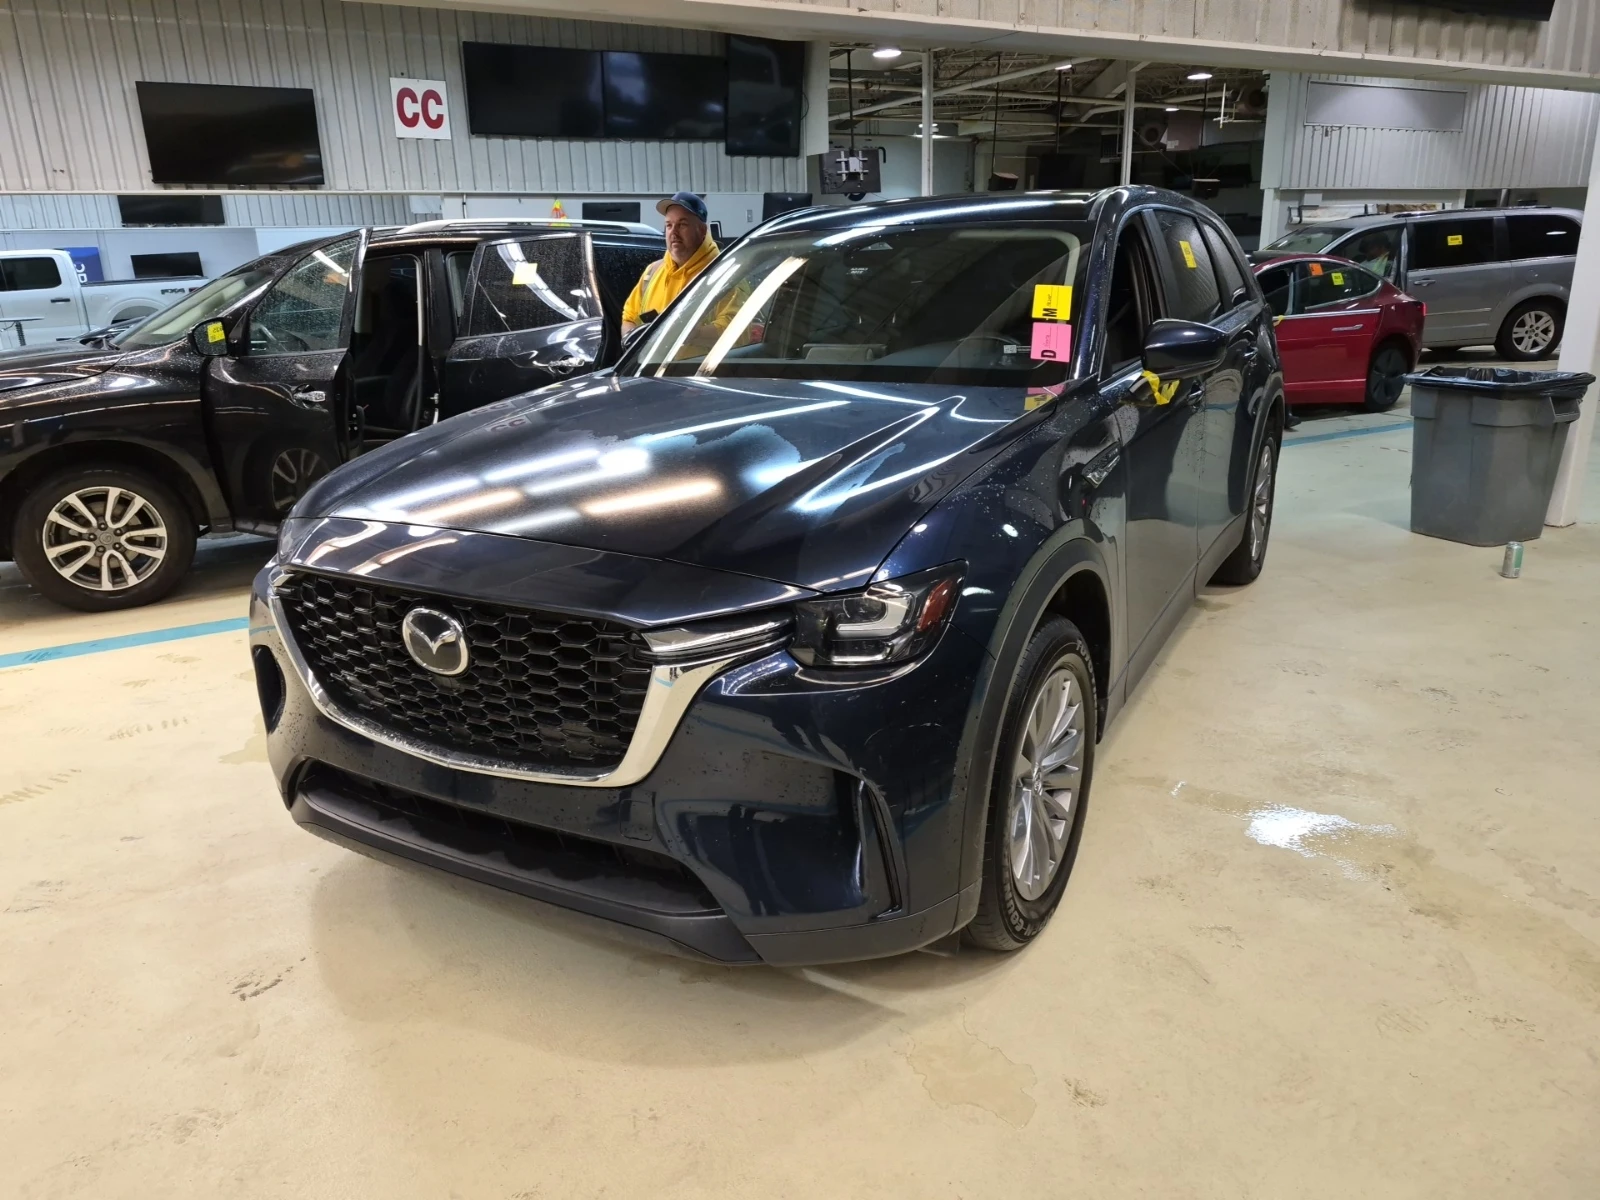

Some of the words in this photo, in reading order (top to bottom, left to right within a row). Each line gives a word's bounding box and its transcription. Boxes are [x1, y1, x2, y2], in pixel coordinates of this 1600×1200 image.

[396, 86, 444, 130] CC
[1042, 308, 1057, 317] M
[1041, 350, 1057, 359] D
